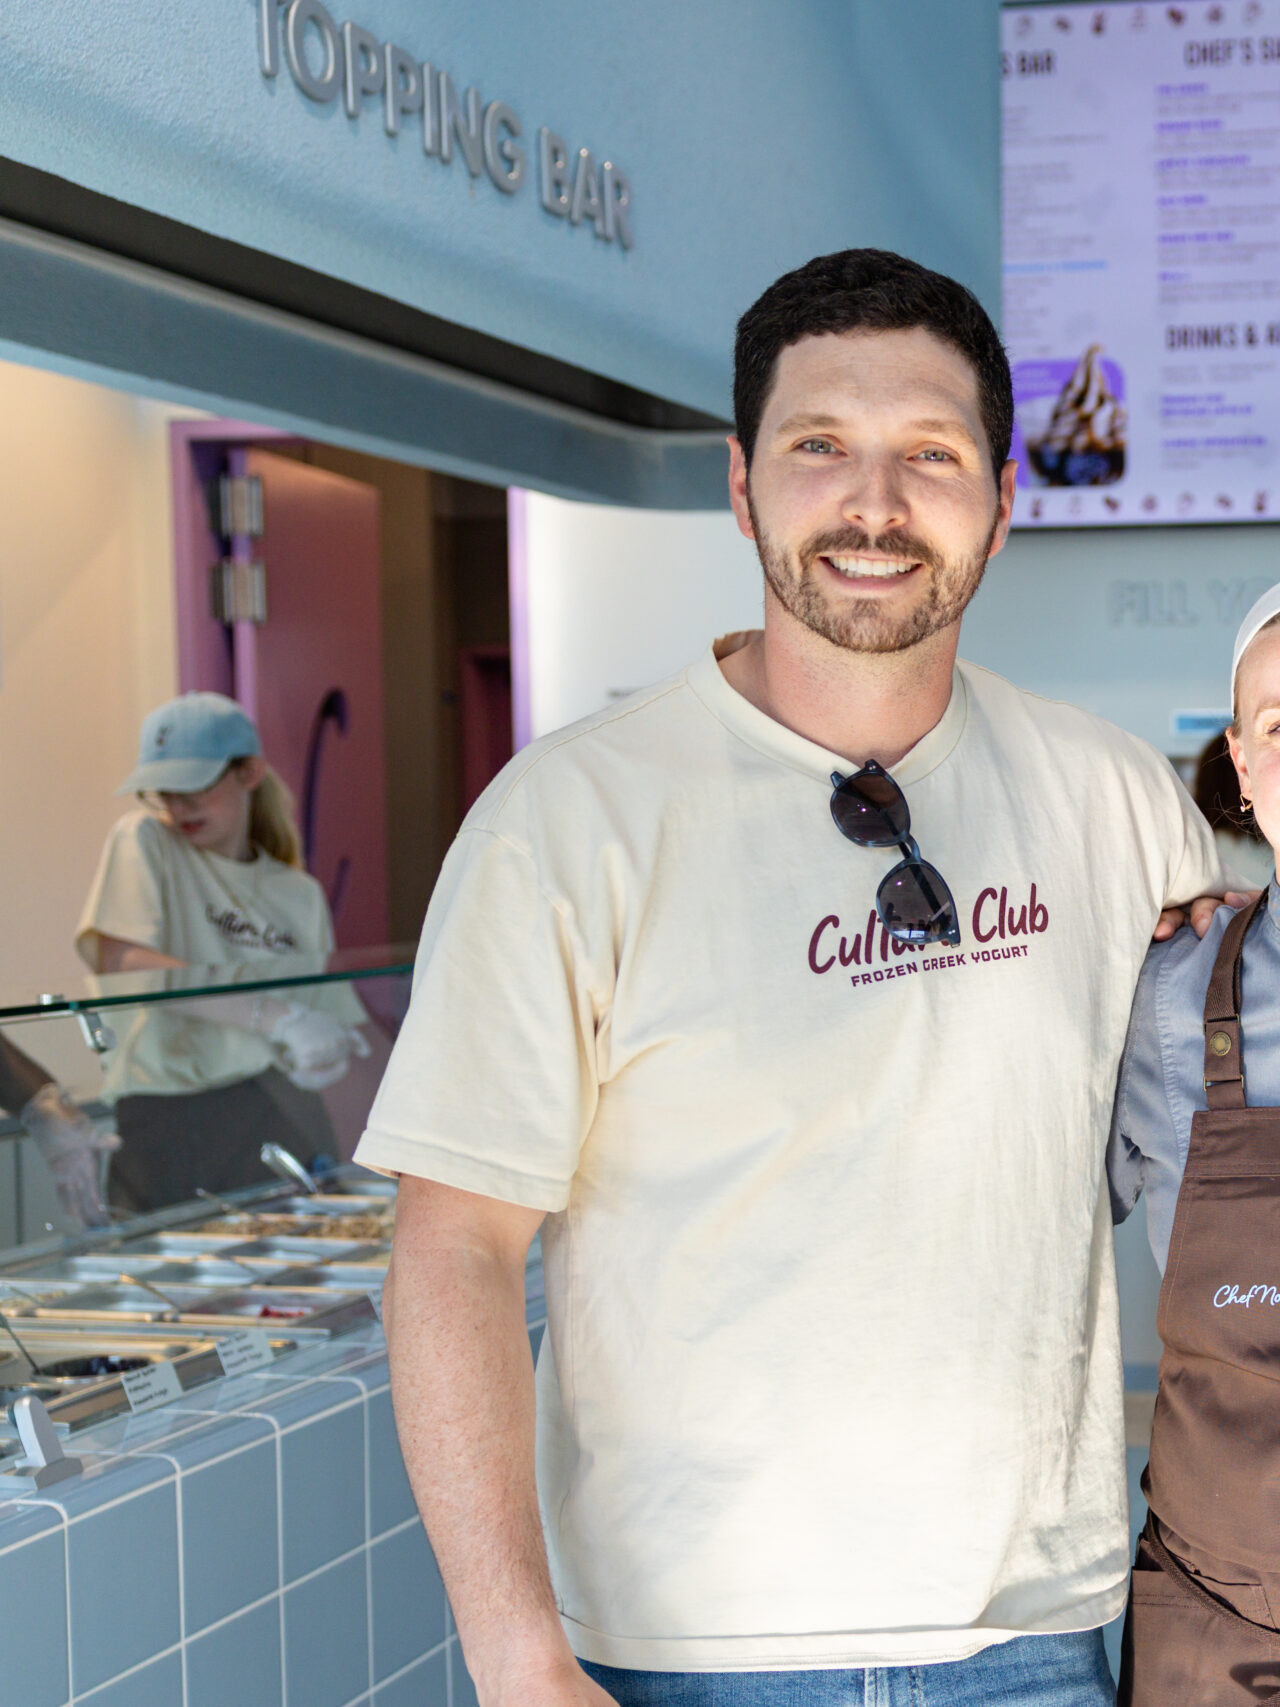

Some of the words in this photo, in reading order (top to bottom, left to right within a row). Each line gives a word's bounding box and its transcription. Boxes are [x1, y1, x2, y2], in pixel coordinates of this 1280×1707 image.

[1016, 49, 1056, 77] BAR
[1184, 36, 1254, 70] CHEF'S
[256, 0, 525, 193] TOPPING
[540, 126, 633, 250] BAR
[1166, 322, 1237, 349] DRINKS
[1243, 321, 1258, 345] &
[1107, 577, 1198, 627] FILL
[808, 902, 955, 975] Cultu
[972, 882, 1050, 944] Club
[851, 962, 918, 987] FROZEN
[923, 953, 967, 972] GREEK
[971, 945, 1029, 963] YOGURT
[1213, 1284, 1258, 1308] Chef
